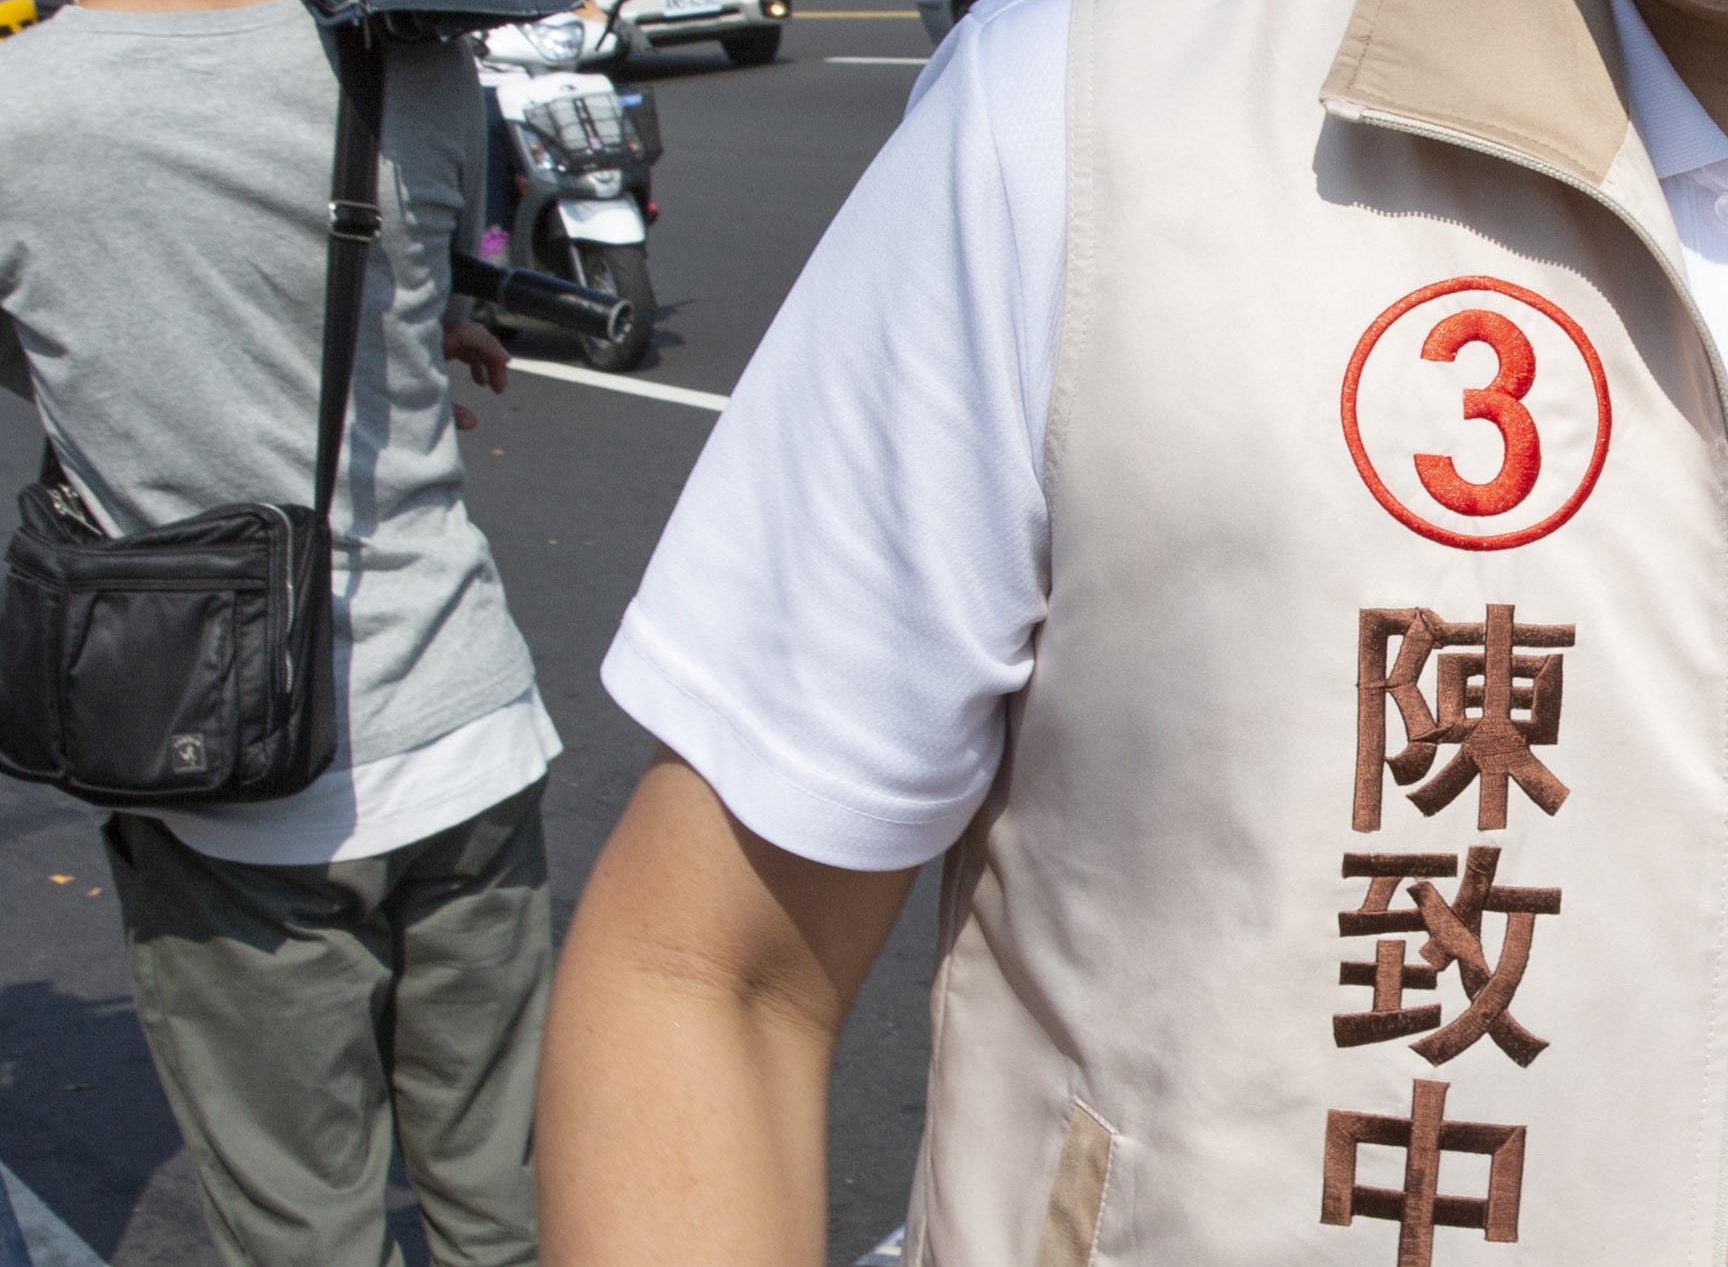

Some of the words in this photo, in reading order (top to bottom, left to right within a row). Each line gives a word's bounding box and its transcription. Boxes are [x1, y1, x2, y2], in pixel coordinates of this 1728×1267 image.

[1413, 308, 1543, 517] 3
[1319, 603, 1577, 1267] 陳致中
